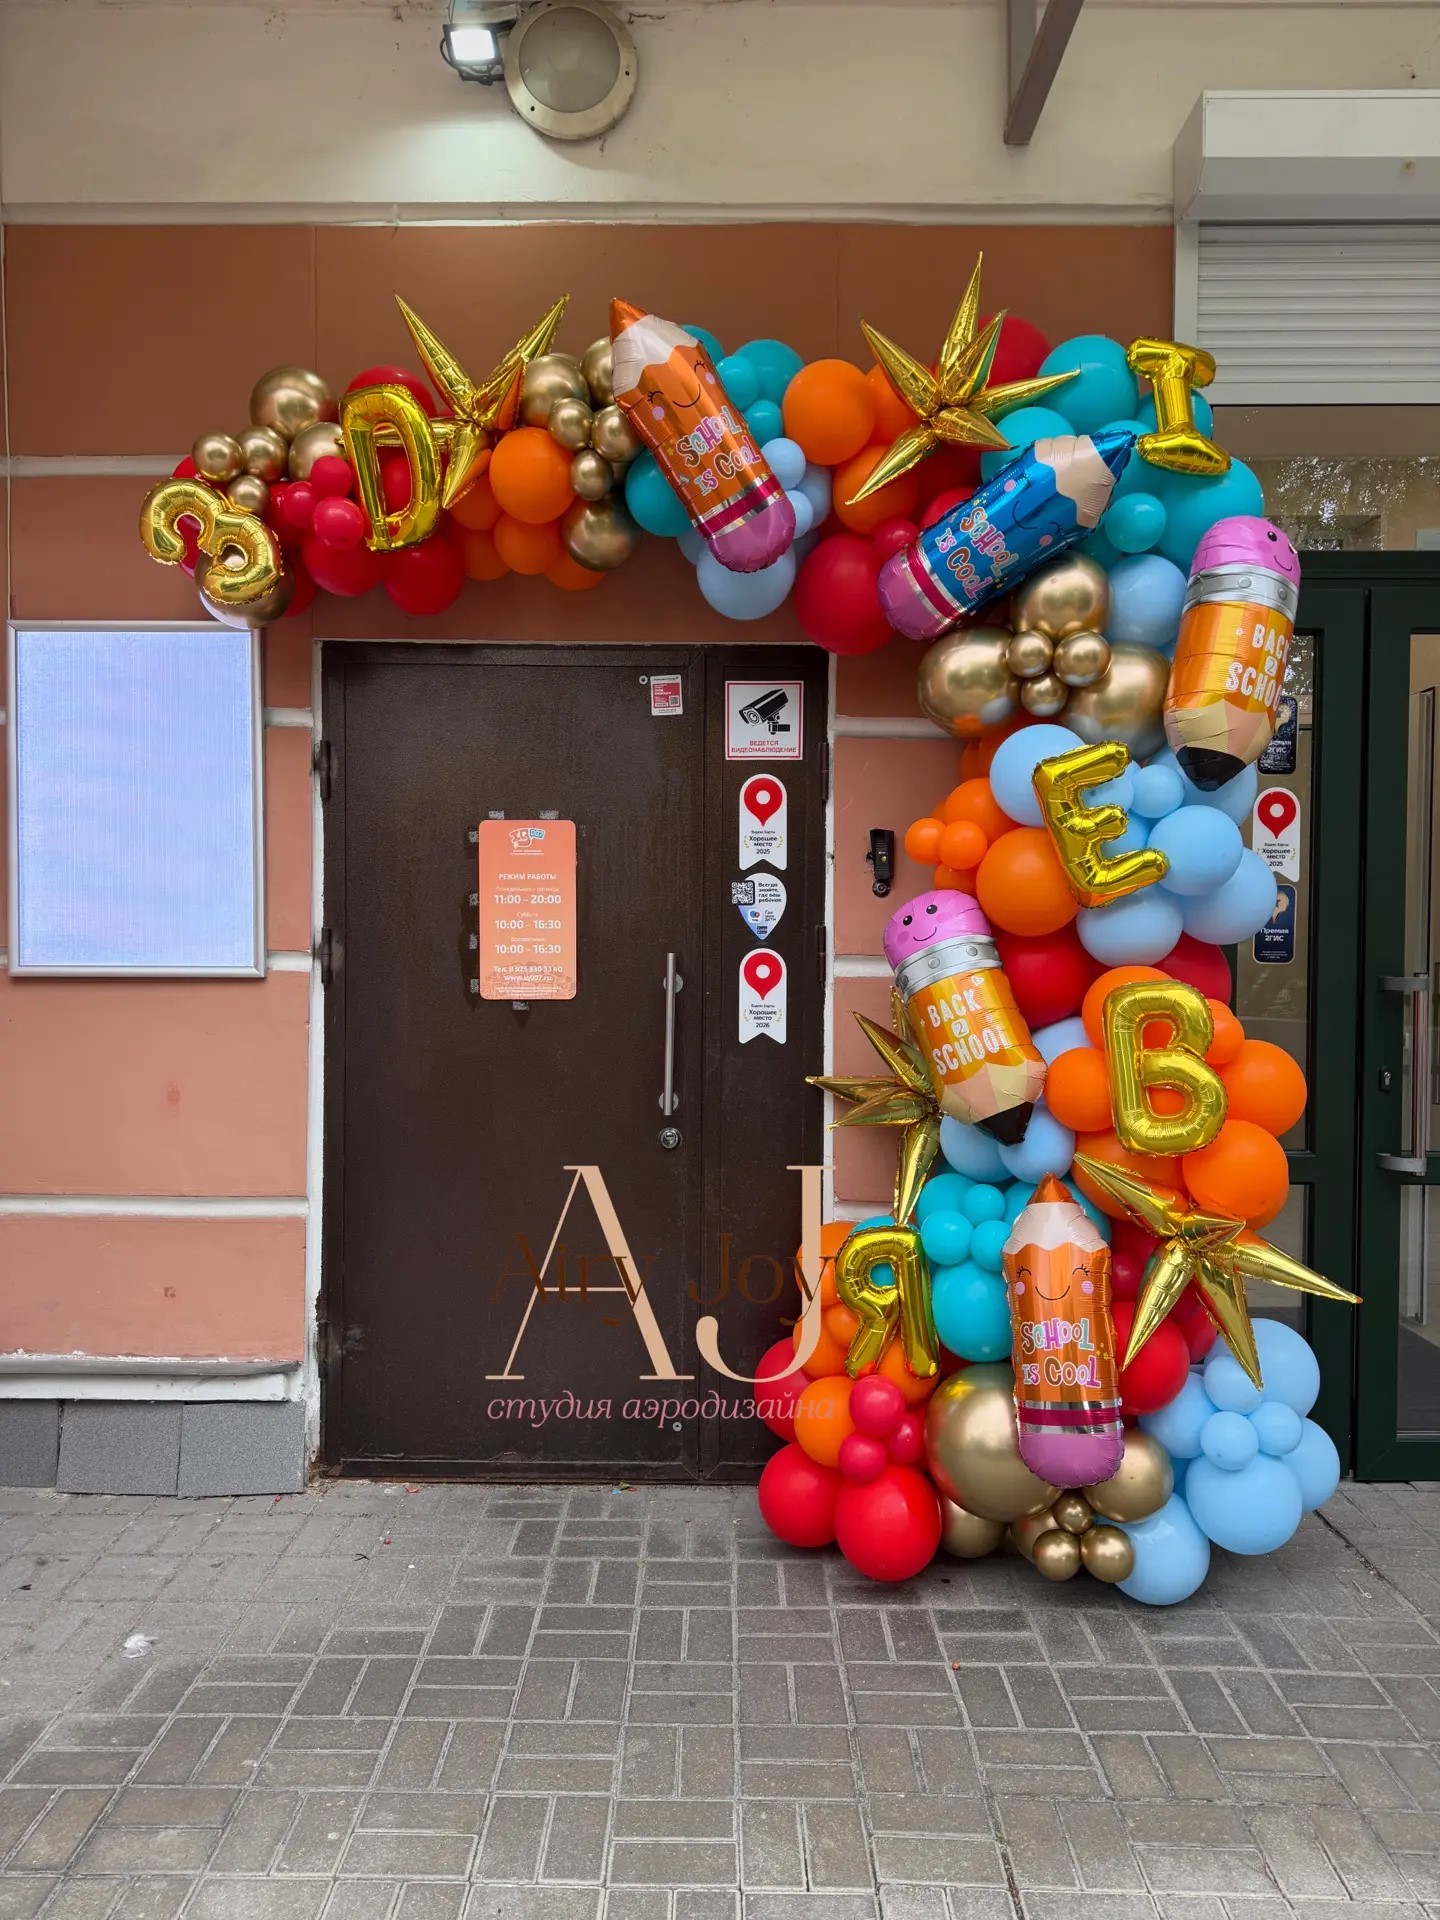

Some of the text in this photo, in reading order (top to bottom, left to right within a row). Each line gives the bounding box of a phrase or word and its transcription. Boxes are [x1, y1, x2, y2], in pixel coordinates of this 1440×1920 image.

[1265, 657, 1277, 675] 2
[749, 835, 778, 843] Хорошее
[494, 895, 521, 904] 11:00
[530, 895, 562, 904] 20:00
[495, 920, 524, 929] 10:00
[533, 920, 561, 929] 16:30
[1260, 927, 1290, 935] Премия
[495, 945, 524, 954] 10:00
[533, 945, 561, 954] 16:30
[927, 989, 982, 1028] BACK
[952, 1019, 968, 1037] 2
[932, 1025, 1013, 1075] SCHOOL
[835, 1225, 941, 1380] Я
